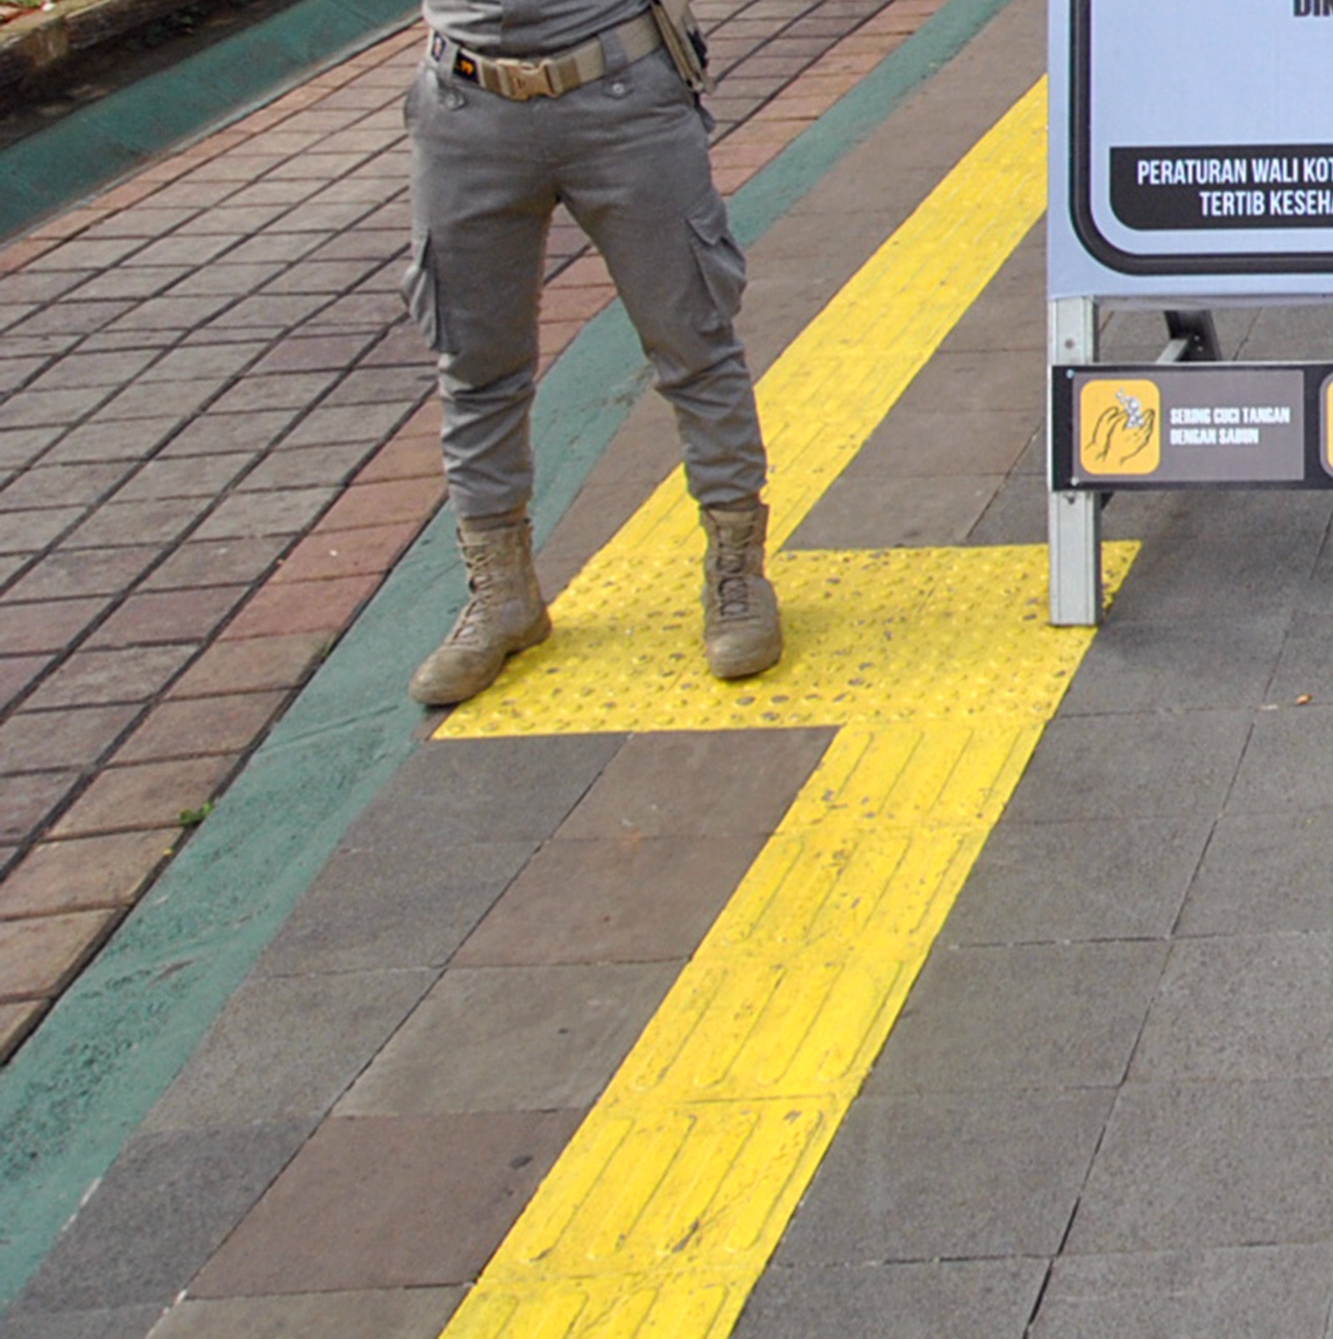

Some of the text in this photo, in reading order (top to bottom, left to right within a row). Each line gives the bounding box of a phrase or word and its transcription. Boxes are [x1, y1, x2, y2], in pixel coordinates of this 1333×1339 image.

[1138, 159, 1247, 184] PERATURAN
[1252, 158, 1298, 183] WALI
[1199, 191, 1265, 216] TERTIB
[1242, 407, 1290, 423] TANGAN
